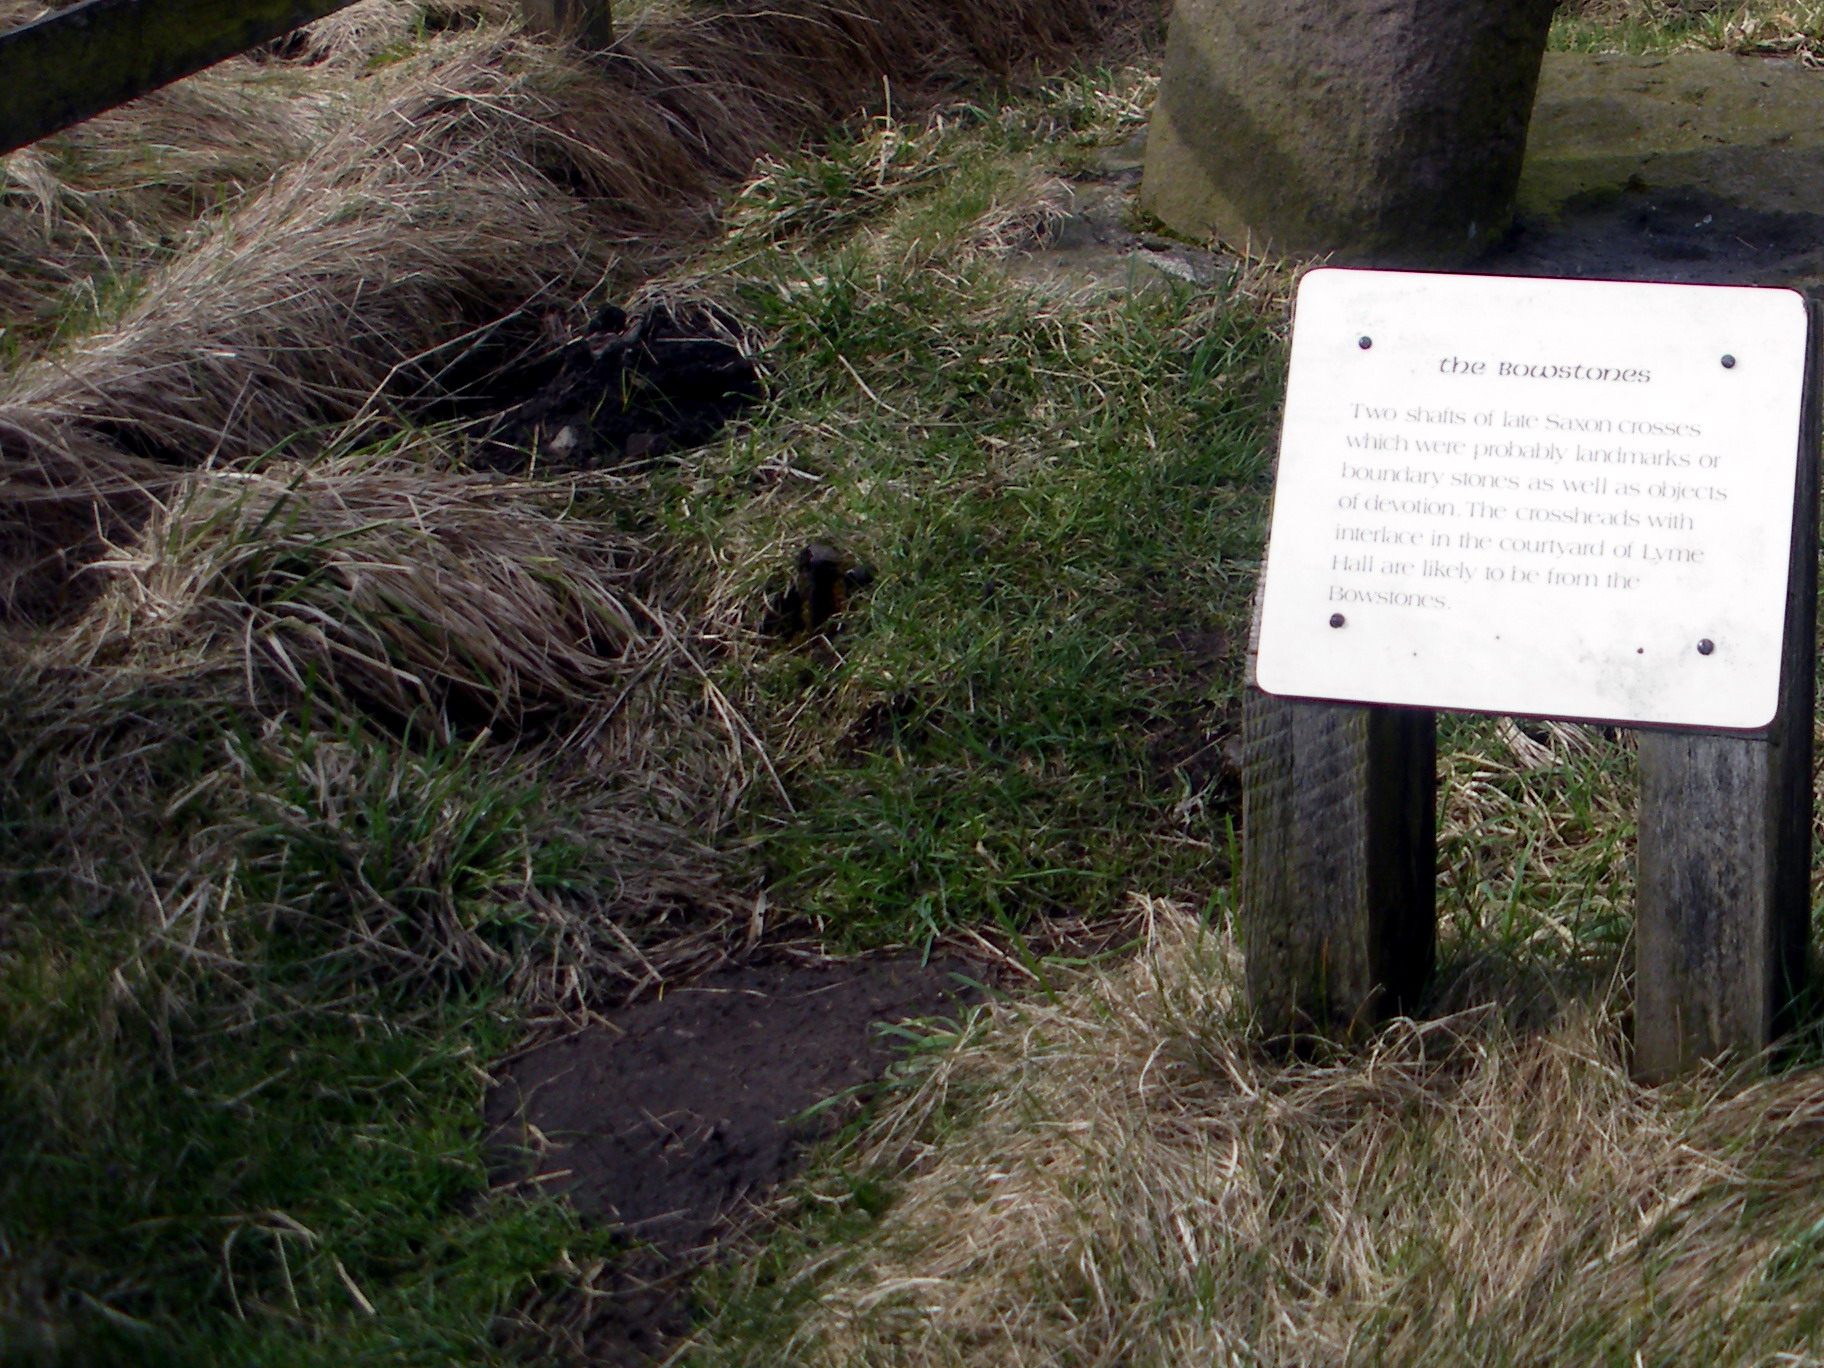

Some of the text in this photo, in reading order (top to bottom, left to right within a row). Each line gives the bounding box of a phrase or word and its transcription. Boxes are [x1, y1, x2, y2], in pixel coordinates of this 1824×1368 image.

[1438, 355, 1652, 384] the Bowstones
[1350, 402, 1702, 438] Two shafts of late Saxon crosses
[1345, 432, 1722, 469] which were probably landmarks or
[1341, 461, 1728, 504] boundary stones as well as objects
[1336, 492, 1695, 531] of devotion. The crossheads with
[1334, 523, 1704, 565] interlace in the courtyard of Lyme
[1330, 554, 1640, 592] Hall are likely to be from the
[1327, 584, 1451, 612] Bowstones.
